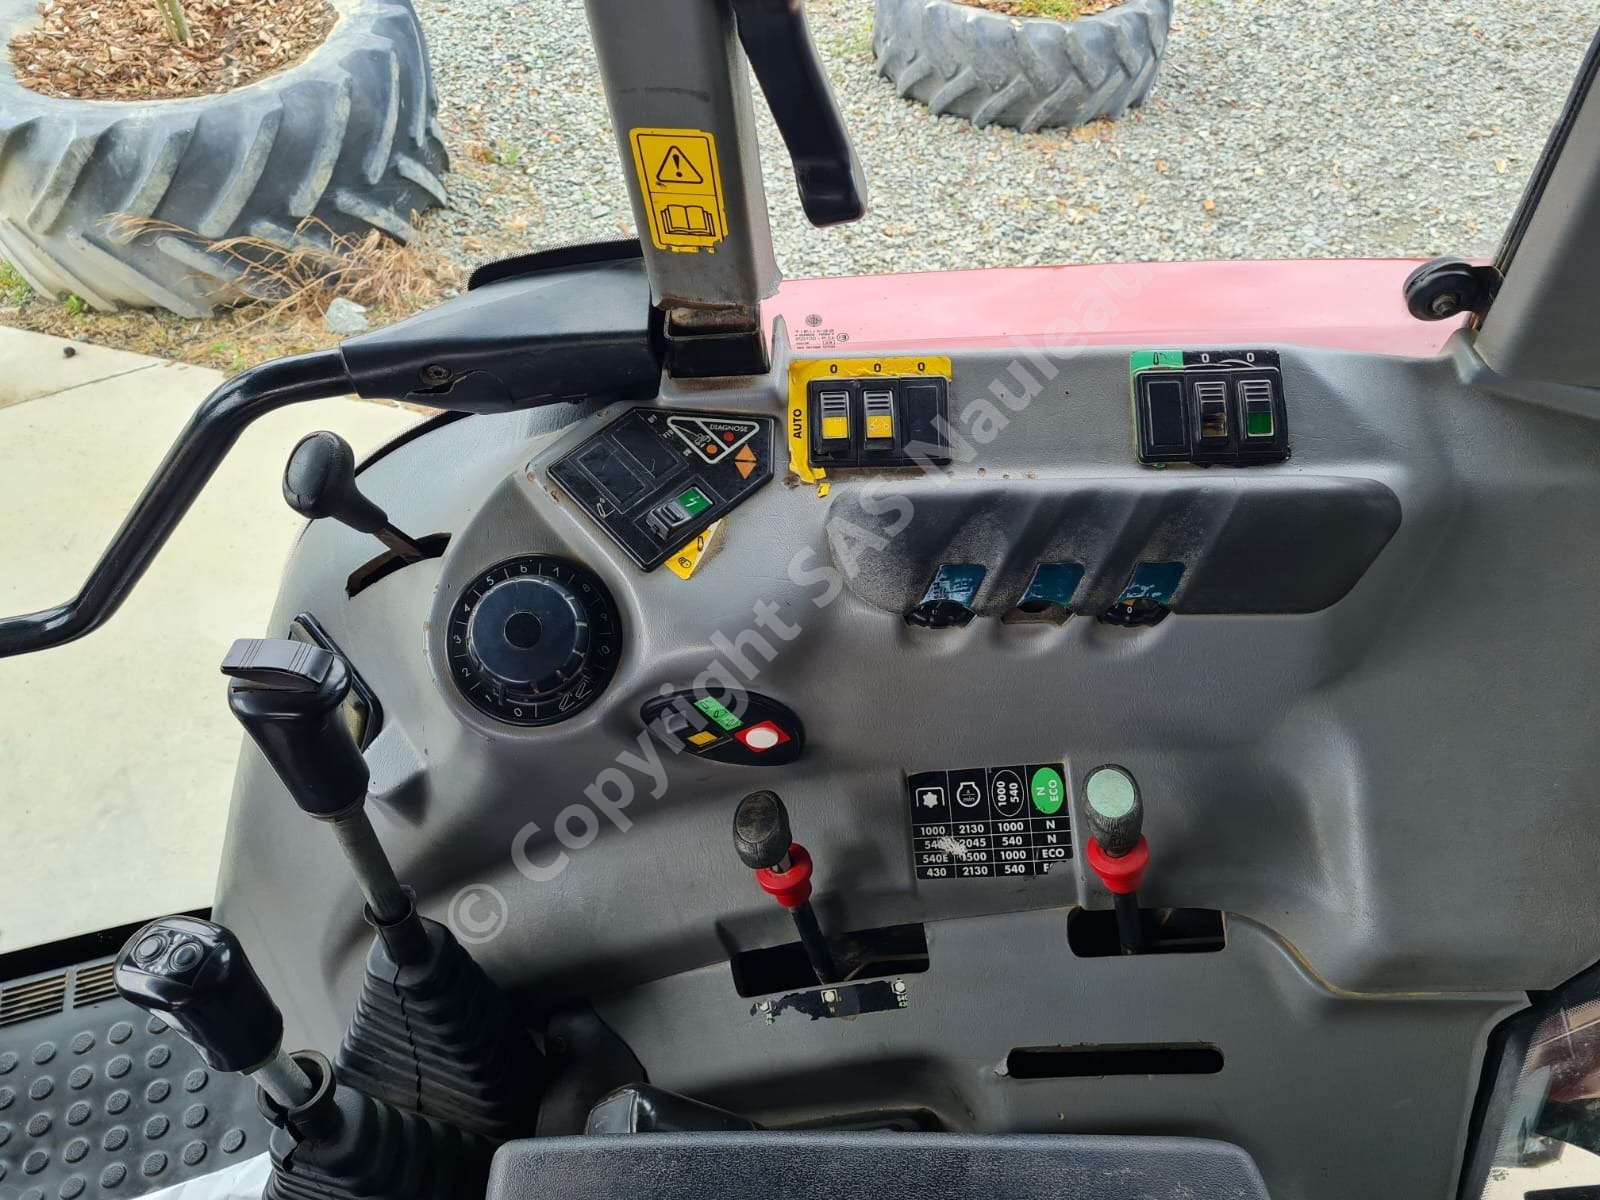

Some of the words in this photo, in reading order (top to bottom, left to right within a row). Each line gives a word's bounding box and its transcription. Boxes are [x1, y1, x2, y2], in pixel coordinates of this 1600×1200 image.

[1202, 353, 1209, 363] 0
[1247, 352, 1255, 362] 0
[830, 364, 837, 373] 0
[874, 363, 881, 372] 0
[918, 362, 925, 371] 0
[710, 424, 749, 433] DIAGNOSE
[793, 408, 802, 439] AUTO
[520, 565, 528, 573] 6
[486, 576, 495, 586] 5
[582, 584, 591, 592] 8
[464, 603, 471, 612] 4
[601, 612, 608, 621] 9
[453, 635, 462, 644] 3
[462, 667, 471, 677] 2
[513, 708, 523, 717] 0
[996, 781, 1007, 806] 1000
[1009, 783, 1019, 803] 540
[1036, 787, 1046, 796] N
[1048, 779, 1059, 802] ECO
[920, 826, 945, 836] 1000
[959, 824, 984, 834] 2130
[997, 821, 1024, 832] 1000
[1046, 820, 1055, 829] N
[1002, 836, 1022, 846] 540
[1047, 834, 1057, 843] N
[923, 854, 948, 863] 540E
[1000, 850, 1026, 860] 1000
[1042, 848, 1064, 858] ECO
[927, 867, 946, 877] 430
[962, 866, 988, 876] 2130
[1004, 864, 1025, 874] 540
